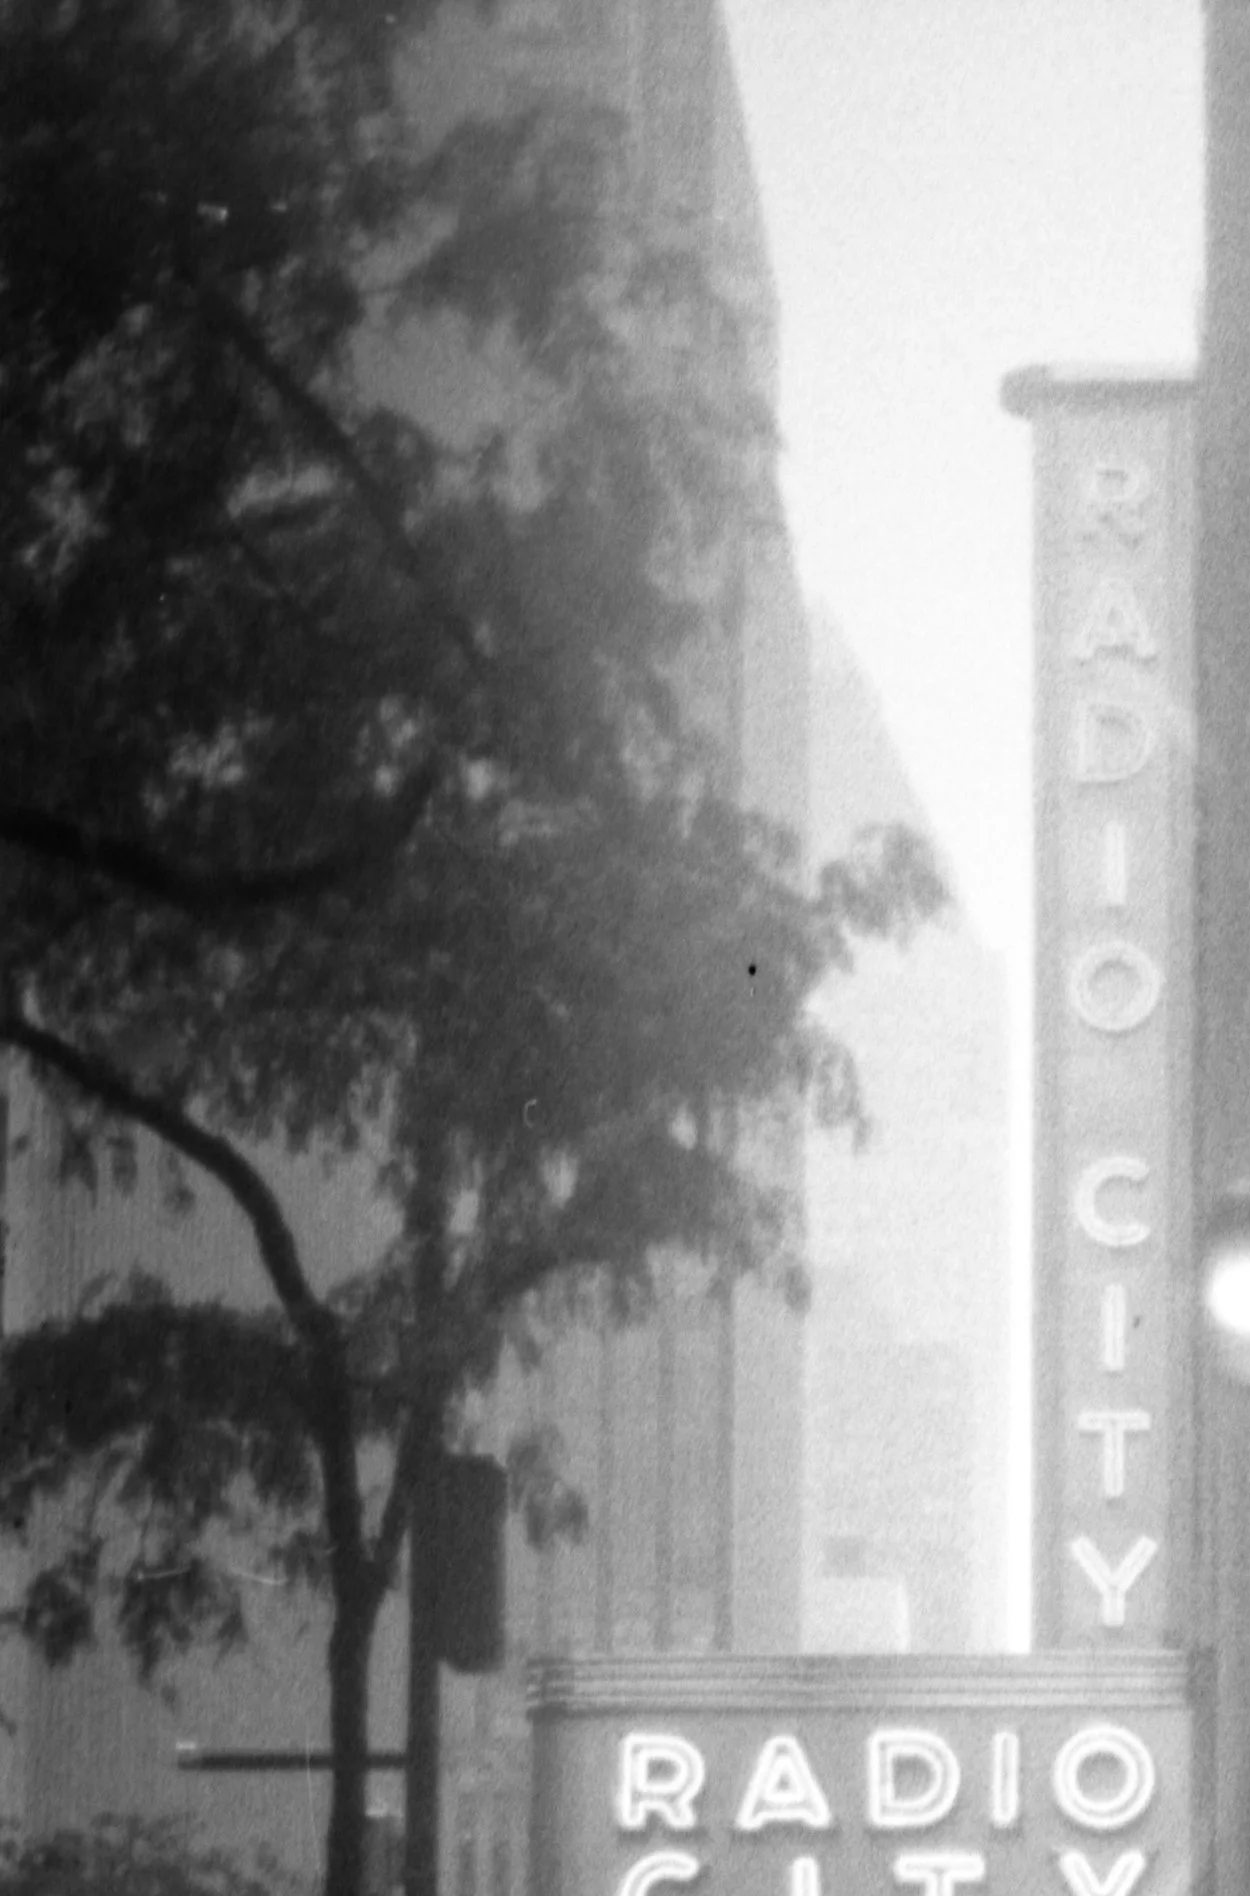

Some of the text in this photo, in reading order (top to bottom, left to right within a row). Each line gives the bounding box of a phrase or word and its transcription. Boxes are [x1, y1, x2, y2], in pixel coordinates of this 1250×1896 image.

[1070, 458, 1166, 1628] RADIO CITY
[616, 1724, 1156, 1832] RADIO
